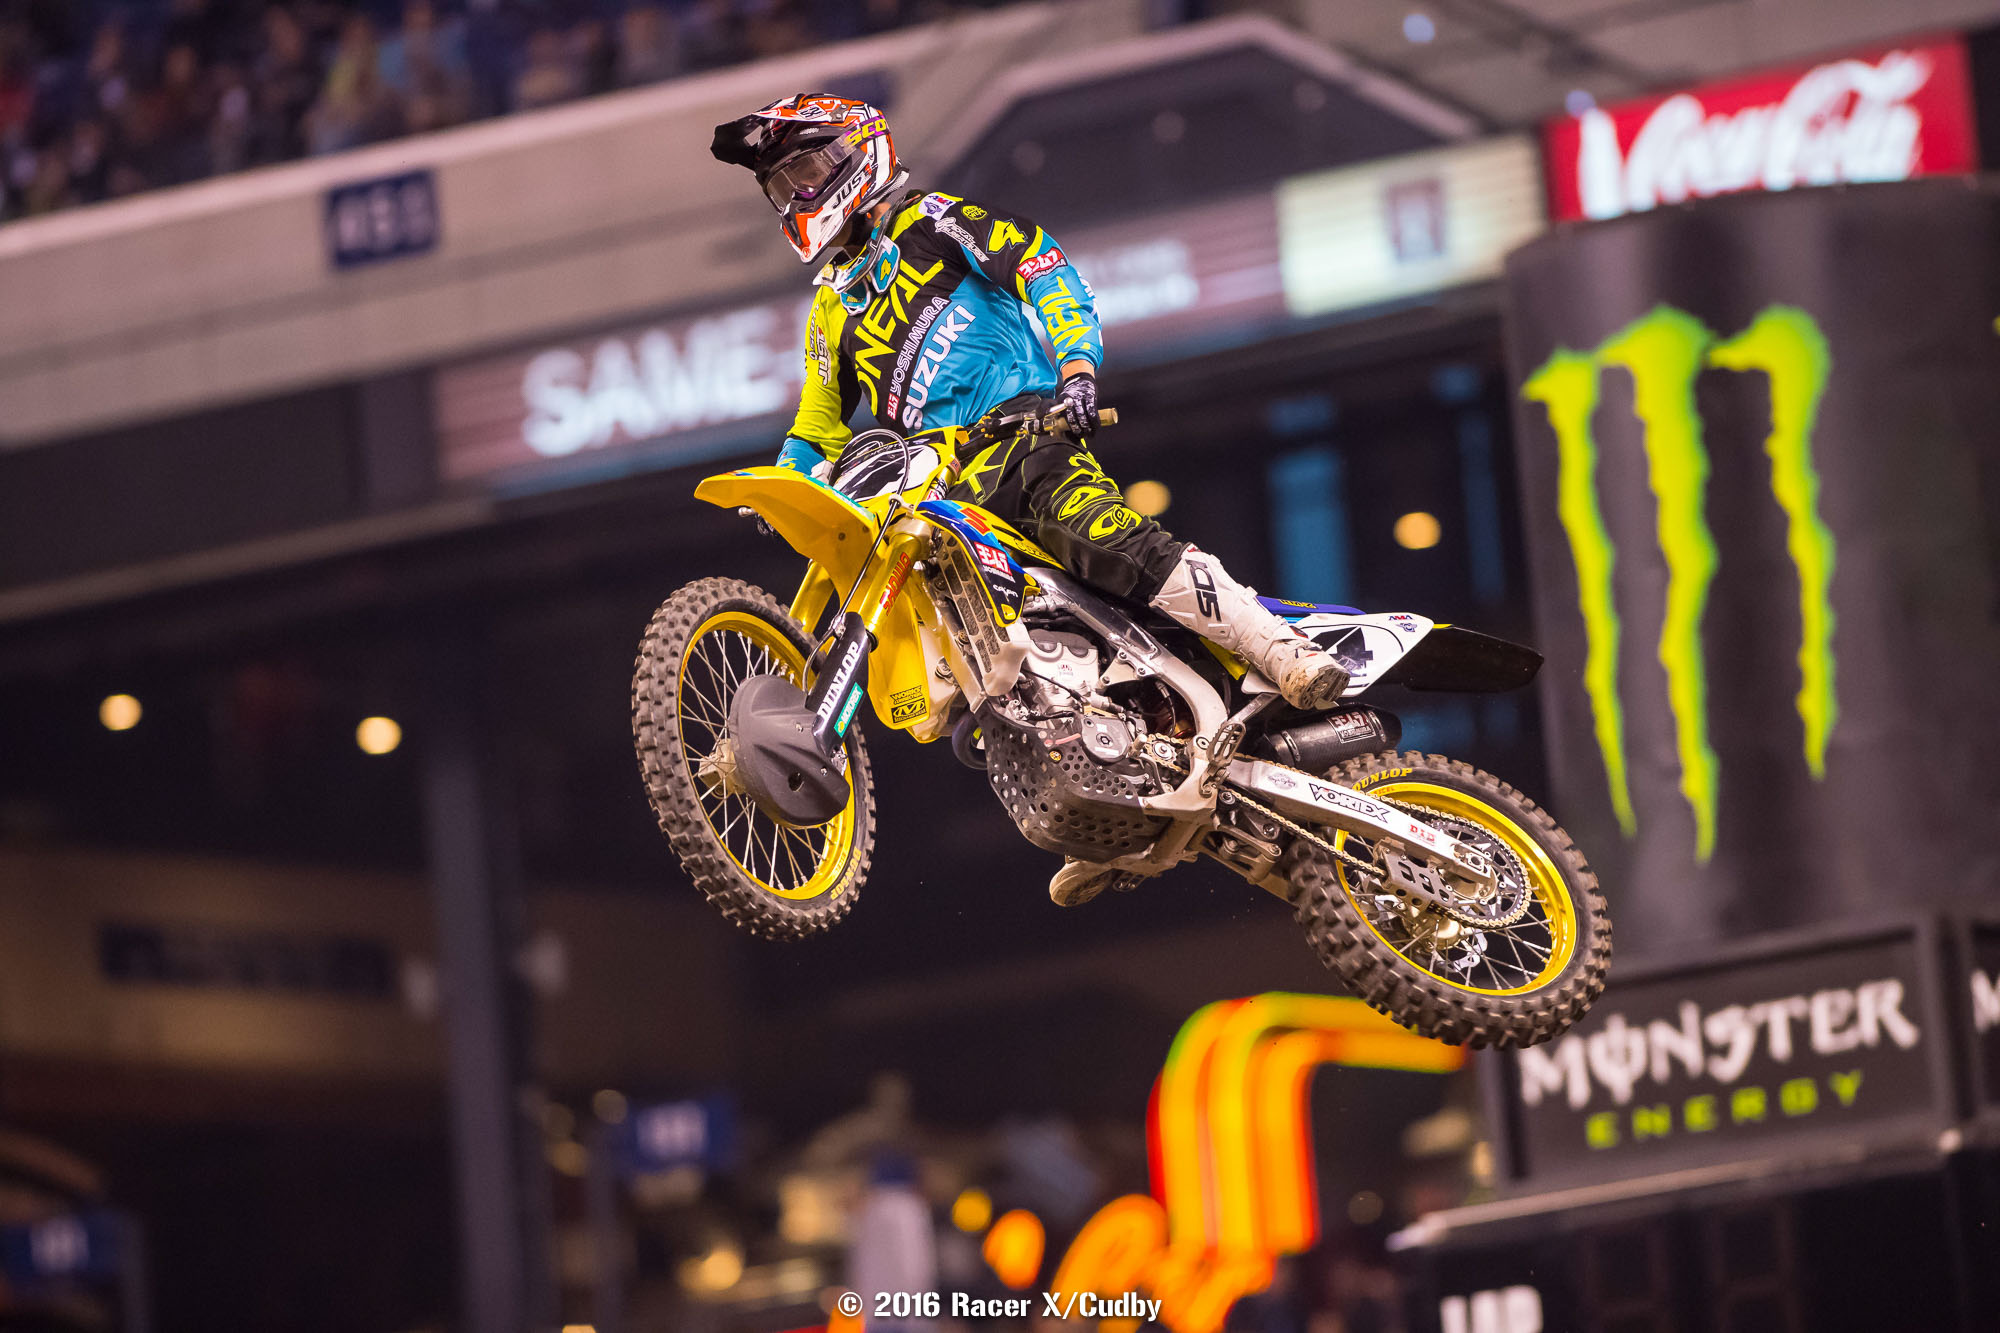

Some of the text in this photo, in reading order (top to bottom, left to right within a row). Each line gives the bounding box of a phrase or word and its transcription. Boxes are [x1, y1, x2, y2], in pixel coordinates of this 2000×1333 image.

[985, 218, 1028, 254] 4
[880, 258, 892, 281] 4
[890, 296, 951, 397] YOSHIMURA
[902, 304, 977, 430] SUZUKI
[816, 641, 860, 722] DUNLOP
[841, 686, 862, 727] MOTOREX
[1309, 782, 1391, 823] VORTEX
[1353, 767, 1413, 793] DUNLOP
[830, 846, 862, 900] DUNLOP
[1520, 979, 1920, 1109] MONSTER
[1585, 1069, 1862, 1148] ENERGY
